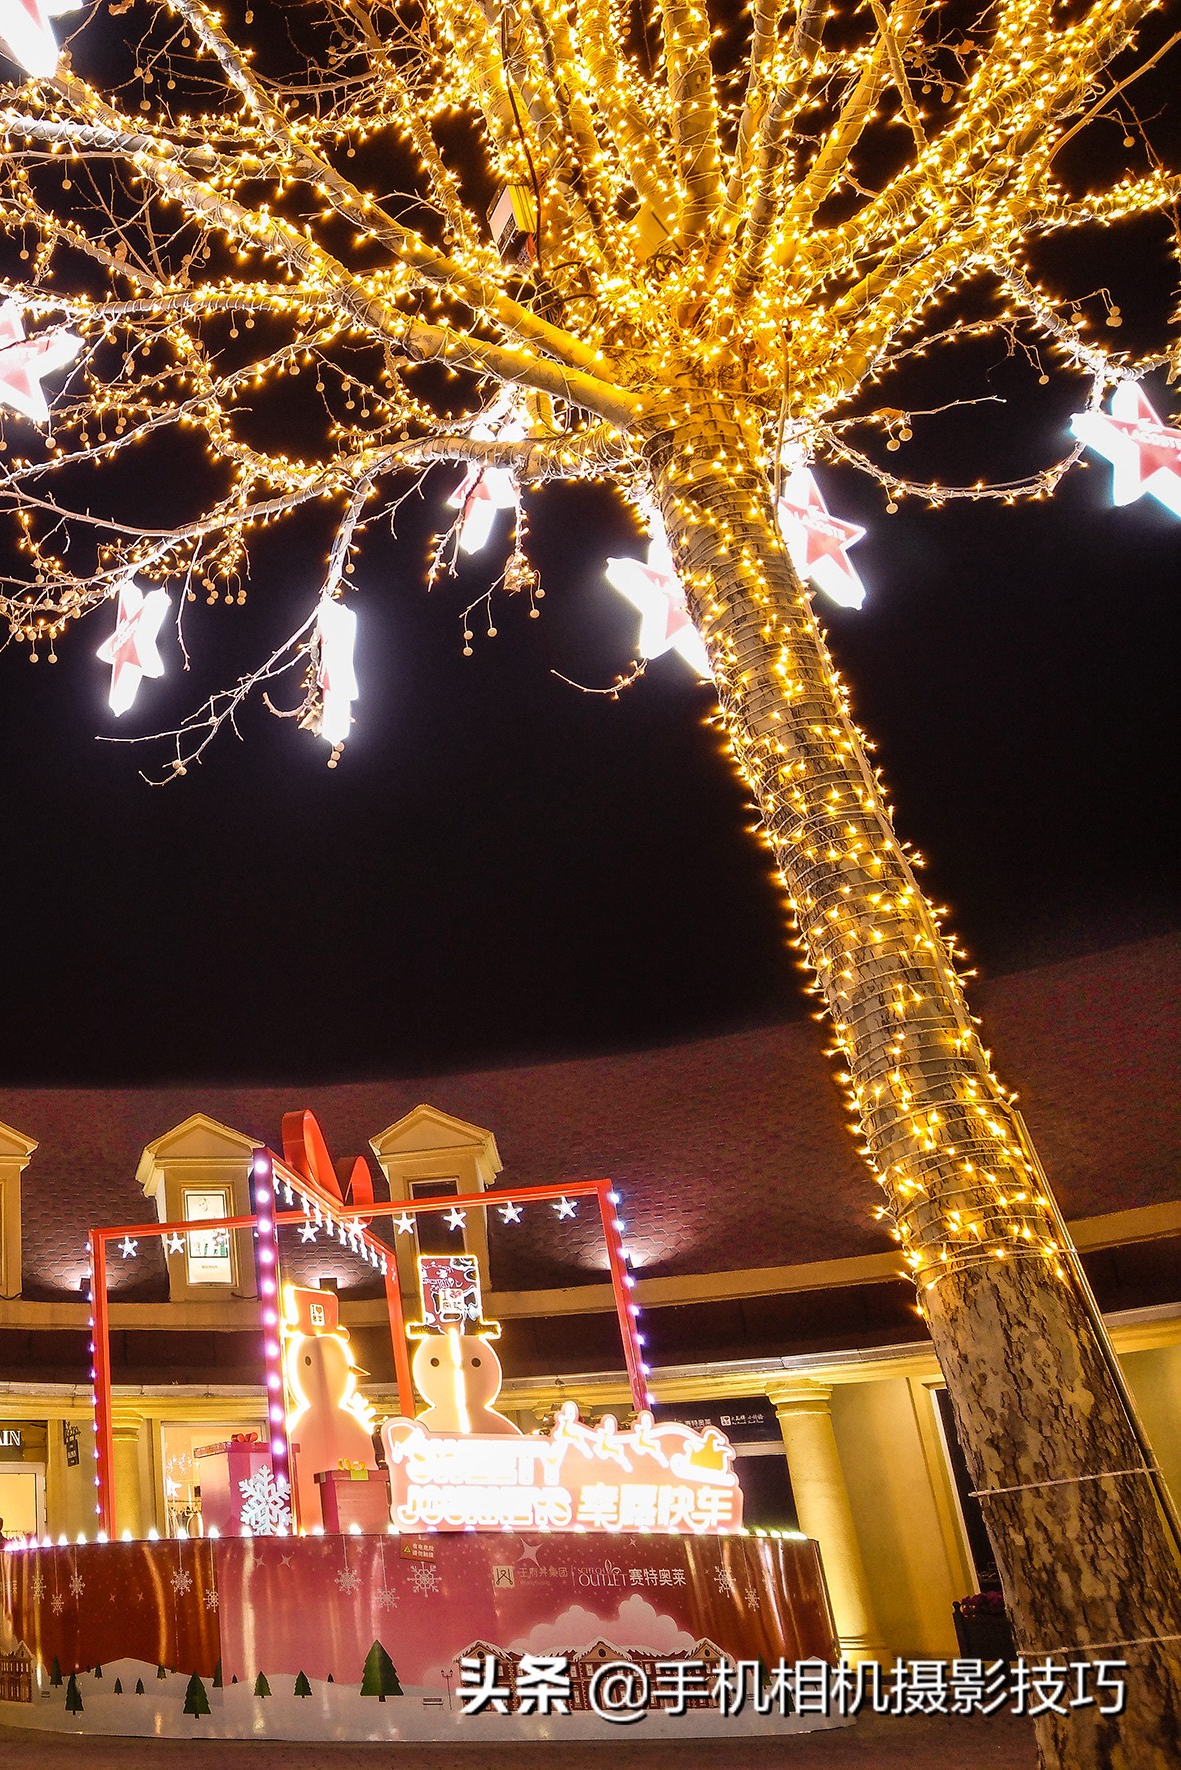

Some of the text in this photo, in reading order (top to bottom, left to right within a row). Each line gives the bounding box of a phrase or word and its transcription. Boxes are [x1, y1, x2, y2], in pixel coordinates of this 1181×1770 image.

[578, 1573, 627, 1587] OUTLET
[628, 1568, 686, 1587] 赛特奥莱
